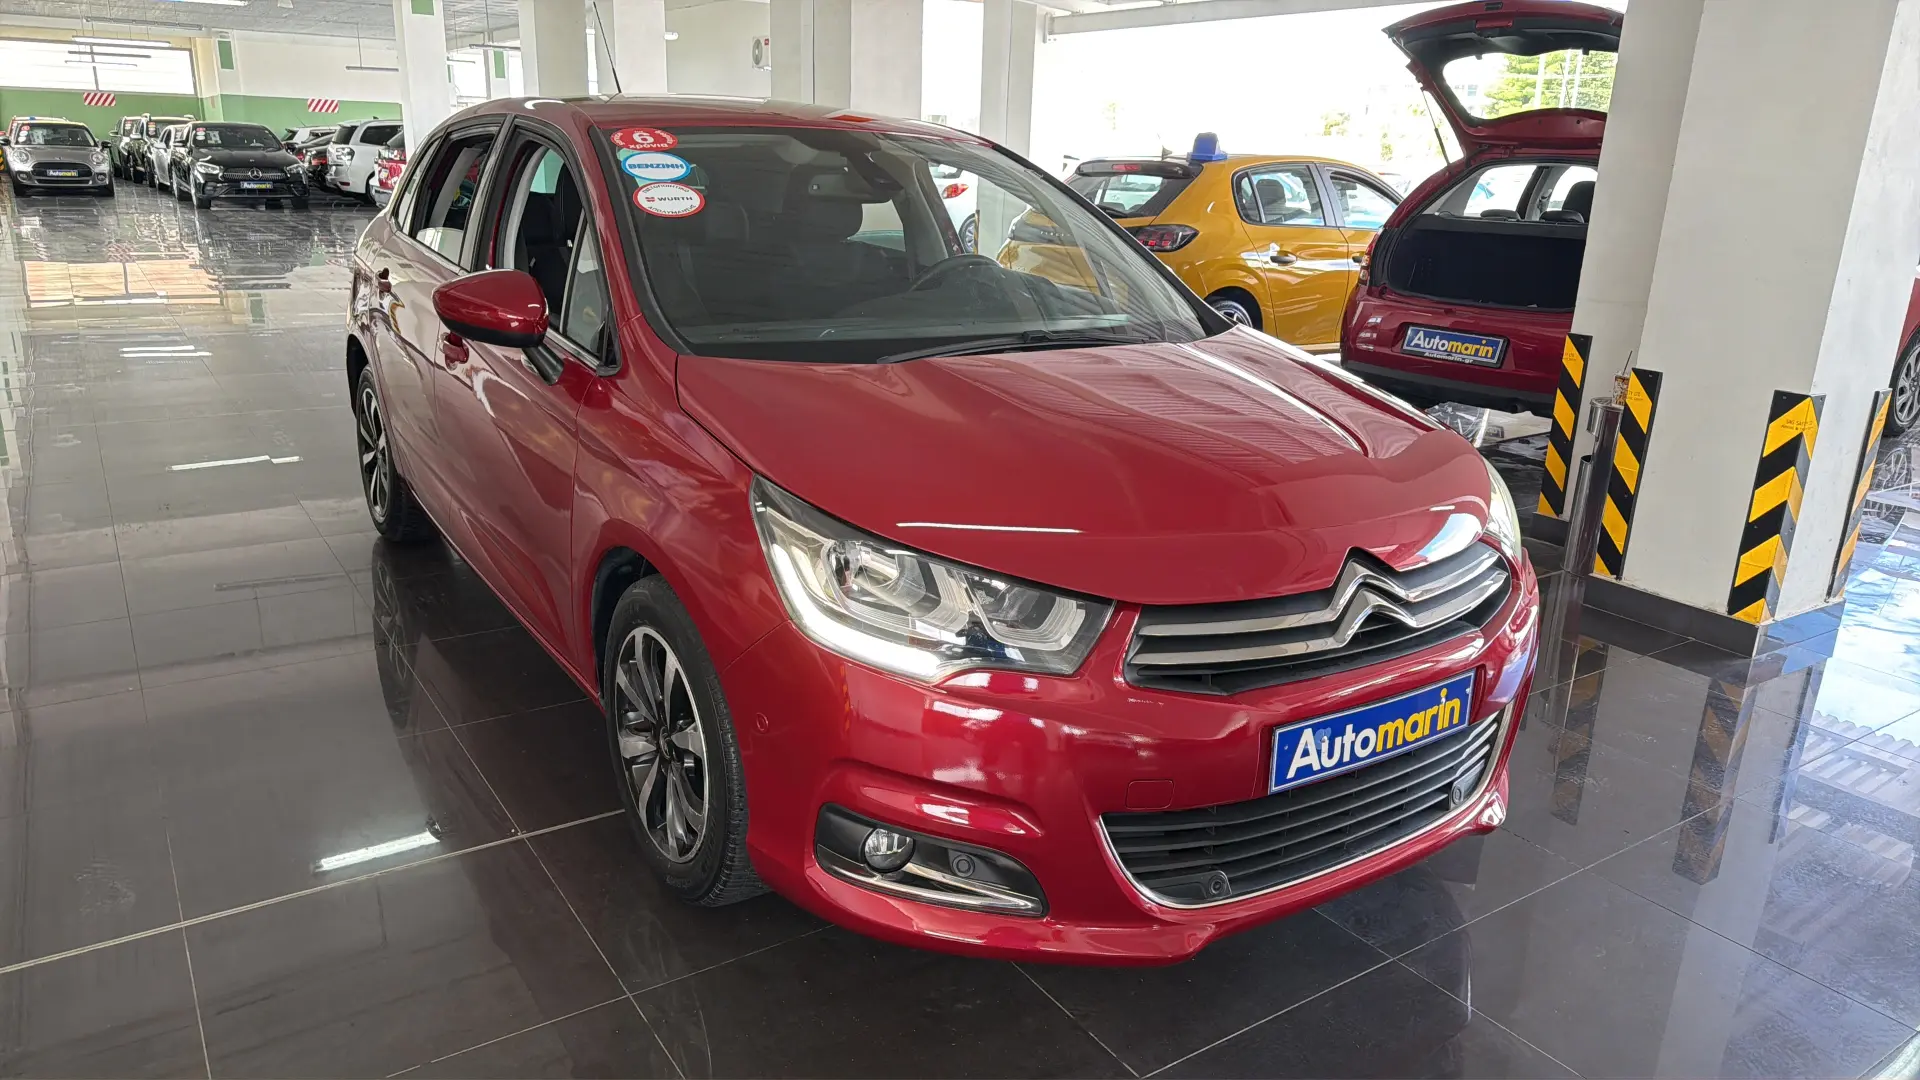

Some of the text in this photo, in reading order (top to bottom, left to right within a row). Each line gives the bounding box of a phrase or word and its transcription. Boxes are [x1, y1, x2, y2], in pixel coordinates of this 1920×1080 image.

[632, 132, 655, 144] 6
[1410, 330, 1493, 358] Automarin
[1423, 351, 1474, 364] Automarin.gr
[1286, 687, 1462, 780] Automarin
